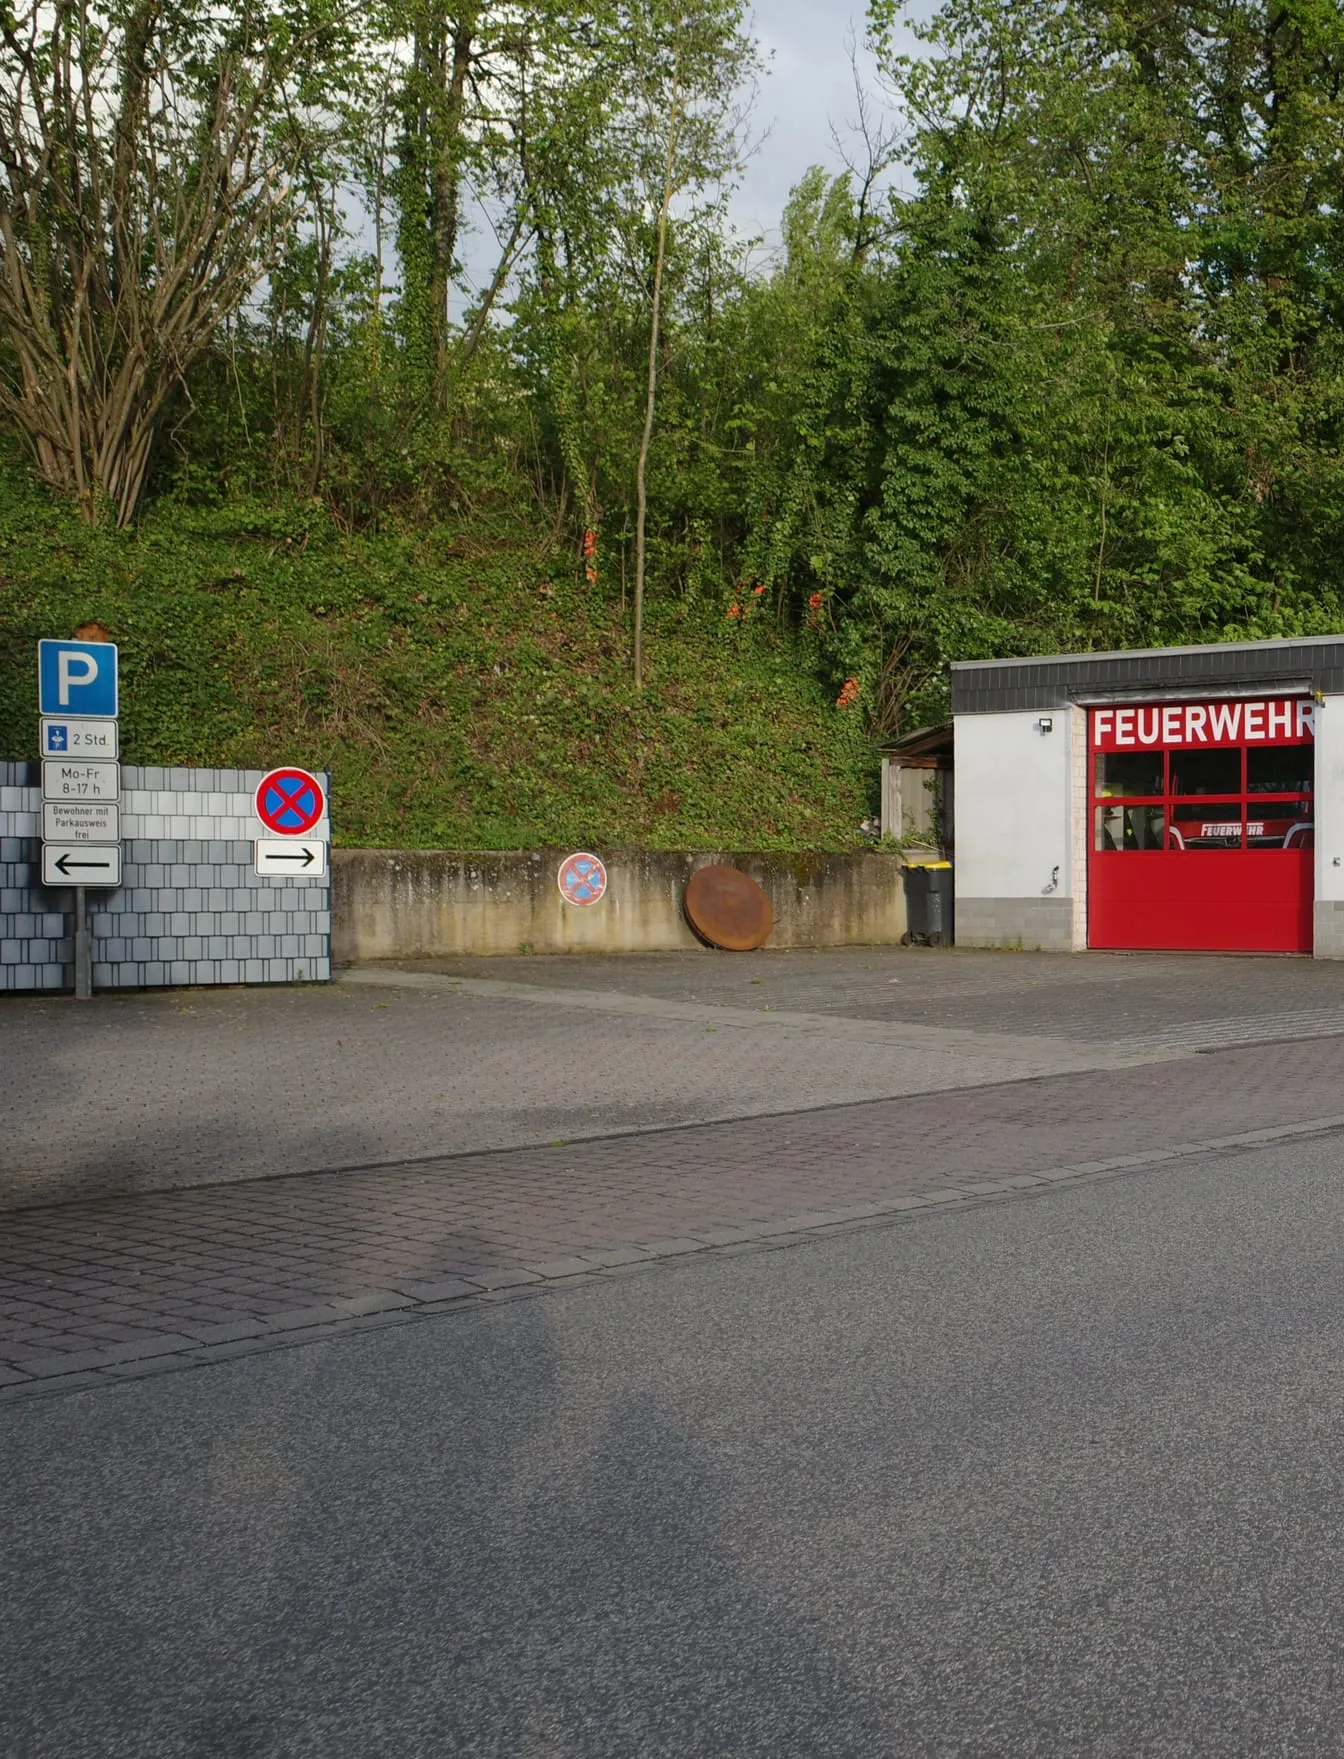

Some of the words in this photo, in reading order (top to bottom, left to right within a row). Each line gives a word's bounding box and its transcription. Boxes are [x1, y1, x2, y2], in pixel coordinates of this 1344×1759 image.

[58, 649, 98, 706] P
[1094, 700, 1315, 746] FEUERWEHR
[73, 733, 81, 745] 2
[84, 734, 110, 746] Std.
[61, 768, 100, 780] Mo-Fr
[62, 782, 89, 795] 8-17
[92, 783, 101, 795] h
[53, 805, 93, 816] Bewohner
[95, 806, 109, 816] mit
[55, 817, 107, 828] Parkausweis
[75, 830, 89, 840] frei
[1200, 822, 1265, 837] FEUERWHR
